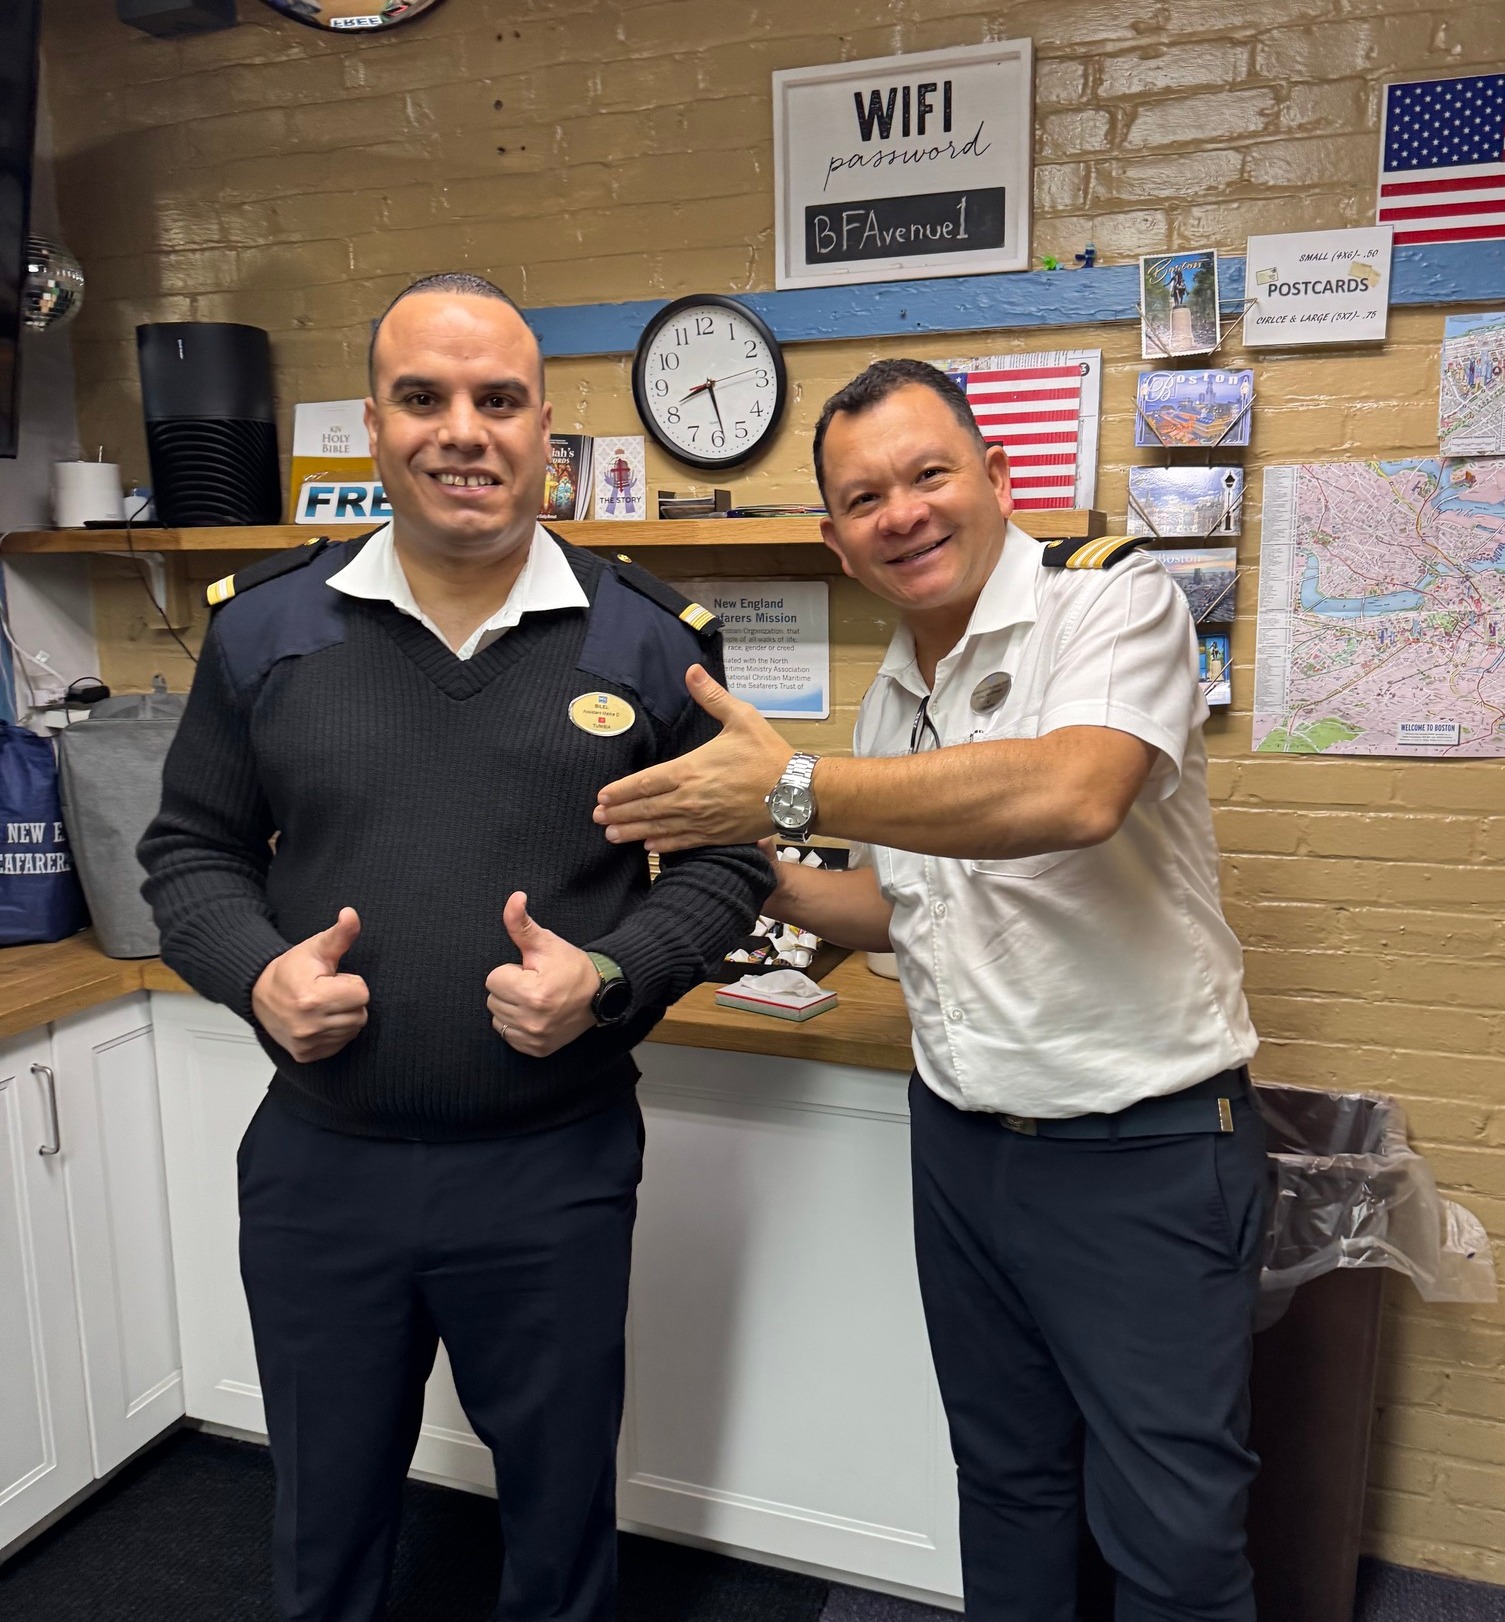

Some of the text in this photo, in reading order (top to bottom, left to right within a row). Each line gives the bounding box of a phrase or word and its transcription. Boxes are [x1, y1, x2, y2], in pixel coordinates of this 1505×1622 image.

[854, 80, 952, 142] WIFI
[824, 120, 992, 192] password
[814, 196, 968, 254] BFAvenue1
[1300, 252, 1328, 262] SMALL
[1363, 250, 1378, 258] .50
[1268, 278, 1369, 297] POSTCARDS
[696, 316, 714, 336] 12
[1256, 315, 1288, 324] CIRLCE
[1300, 312, 1330, 323] LARGE
[1362, 311, 1377, 319] .75
[675, 328, 689, 346] 11
[729, 323, 736, 340] 1
[744, 340, 758, 358] 2
[660, 352, 680, 370] 10
[655, 379, 668, 397] 9
[755, 370, 769, 388] 3
[1144, 372, 1239, 402] Boston
[667, 406, 681, 424] 8
[750, 400, 763, 417] 4
[322, 434, 350, 443] HOLY
[688, 426, 700, 442] 7
[711, 430, 725, 447] 6
[735, 421, 748, 438] 5
[322, 445, 350, 453] BIBLE
[552, 448, 574, 458] iah's
[305, 486, 394, 517] FRE
[617, 496, 642, 504] STORY
[1159, 553, 1200, 563] Boston
[714, 598, 784, 610] New England
[716, 613, 797, 623] farers Mission
[7, 822, 65, 843] NEW E
[0, 852, 70, 874] AFARER
